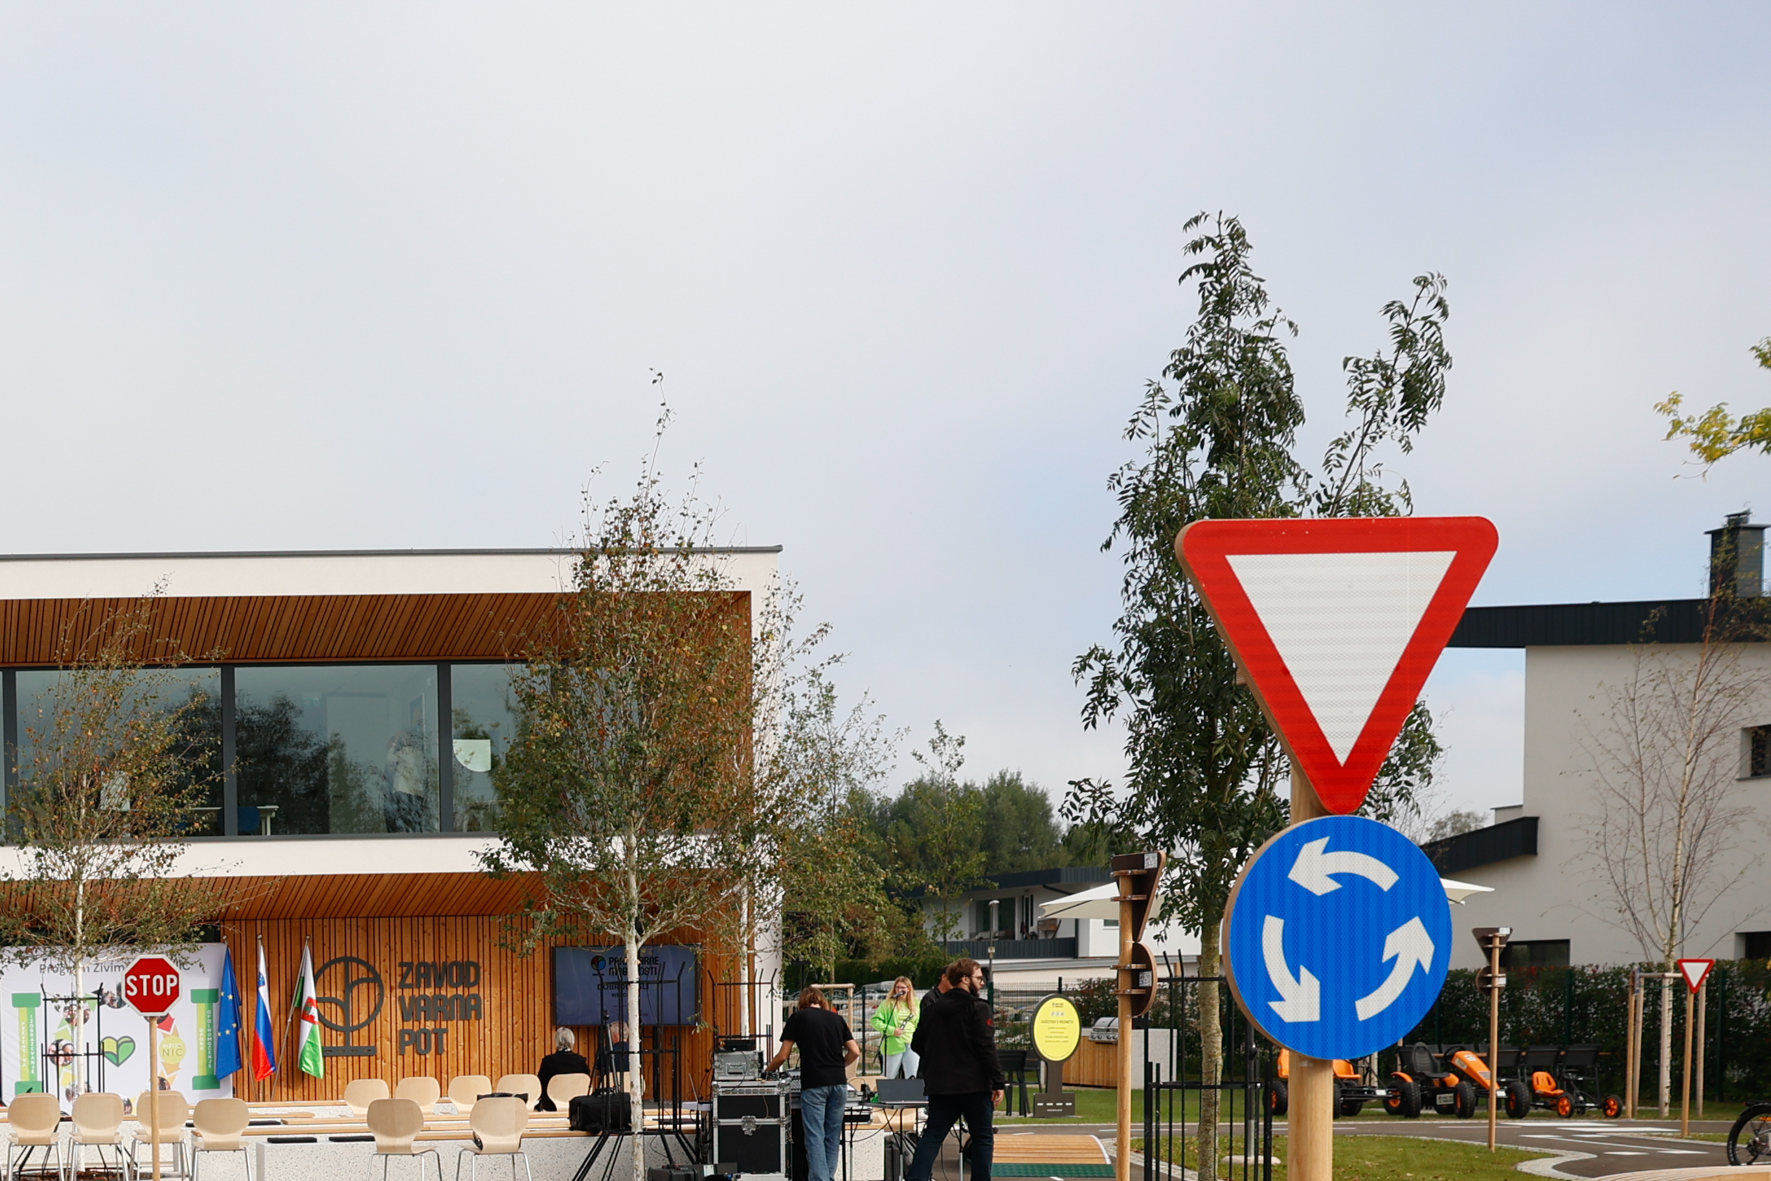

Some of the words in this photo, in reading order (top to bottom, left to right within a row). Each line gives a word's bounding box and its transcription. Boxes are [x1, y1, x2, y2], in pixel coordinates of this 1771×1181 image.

[126, 974, 178, 996] STOP
[398, 961, 481, 989] ZAVOD
[399, 993, 482, 1021] VARNA
[163, 1048, 183, 1057] NIC
[399, 1028, 448, 1055] POT
